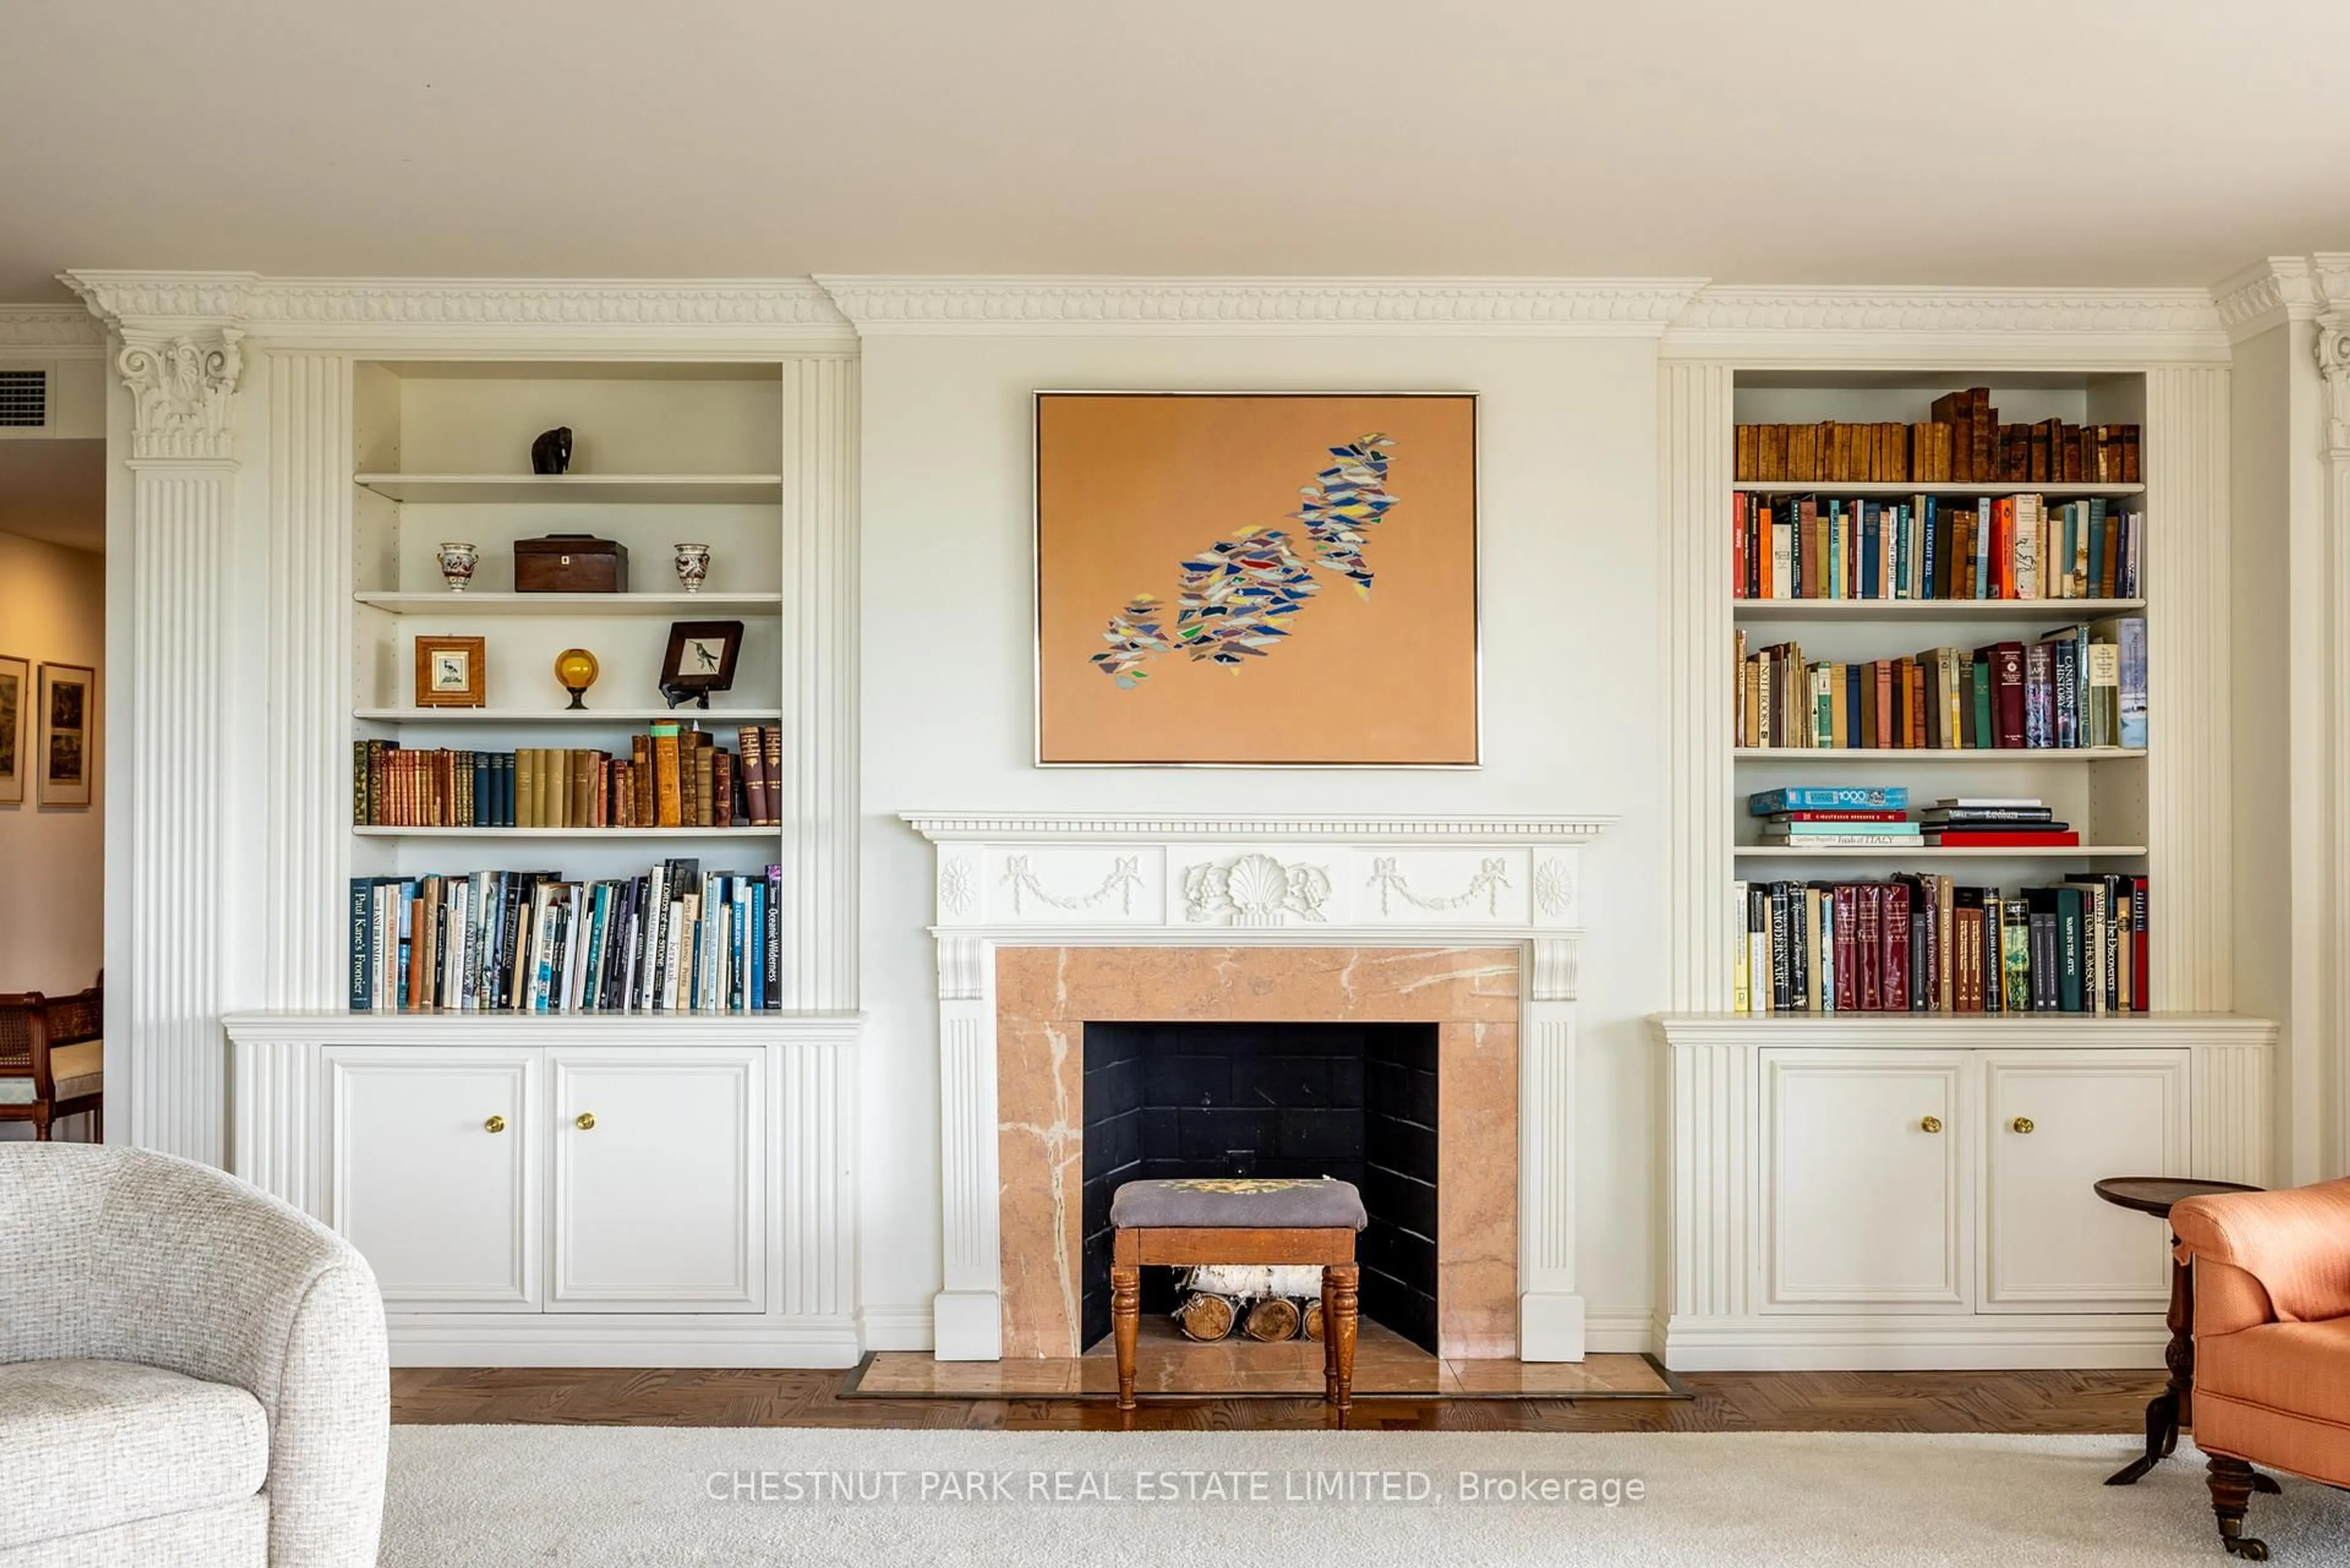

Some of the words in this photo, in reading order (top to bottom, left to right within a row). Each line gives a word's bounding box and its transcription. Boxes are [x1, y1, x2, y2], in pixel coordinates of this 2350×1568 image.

[2057, 664, 2065, 707] HISTORY
[2065, 655, 2074, 708] CANADIAN
[1760, 665, 1769, 727] NOTEBOOKS
[1839, 791, 1866, 801] 1000
[1865, 835, 1894, 844] ITALY
[355, 894, 366, 914] Paul
[662, 883, 671, 911] LORDS
[684, 899, 693, 914] Arts
[659, 924, 668, 938] the
[660, 913, 668, 922] of
[685, 914, 692, 923] of
[769, 908, 778, 939] Oceanic
[2086, 912, 2094, 935] TOM
[2107, 917, 2117, 938] The
[355, 919, 366, 950] Kane's
[1774, 910, 1784, 961] MODERN
[657, 939, 666, 967] STONE
[768, 939, 779, 982] Wilderness
[2086, 939, 2094, 991] THOMSON
[2107, 938, 2117, 991] Discoverers
[355, 954, 366, 994] Frontier
[681, 967, 690, 987] Prints
[1775, 964, 1785, 988] ART
